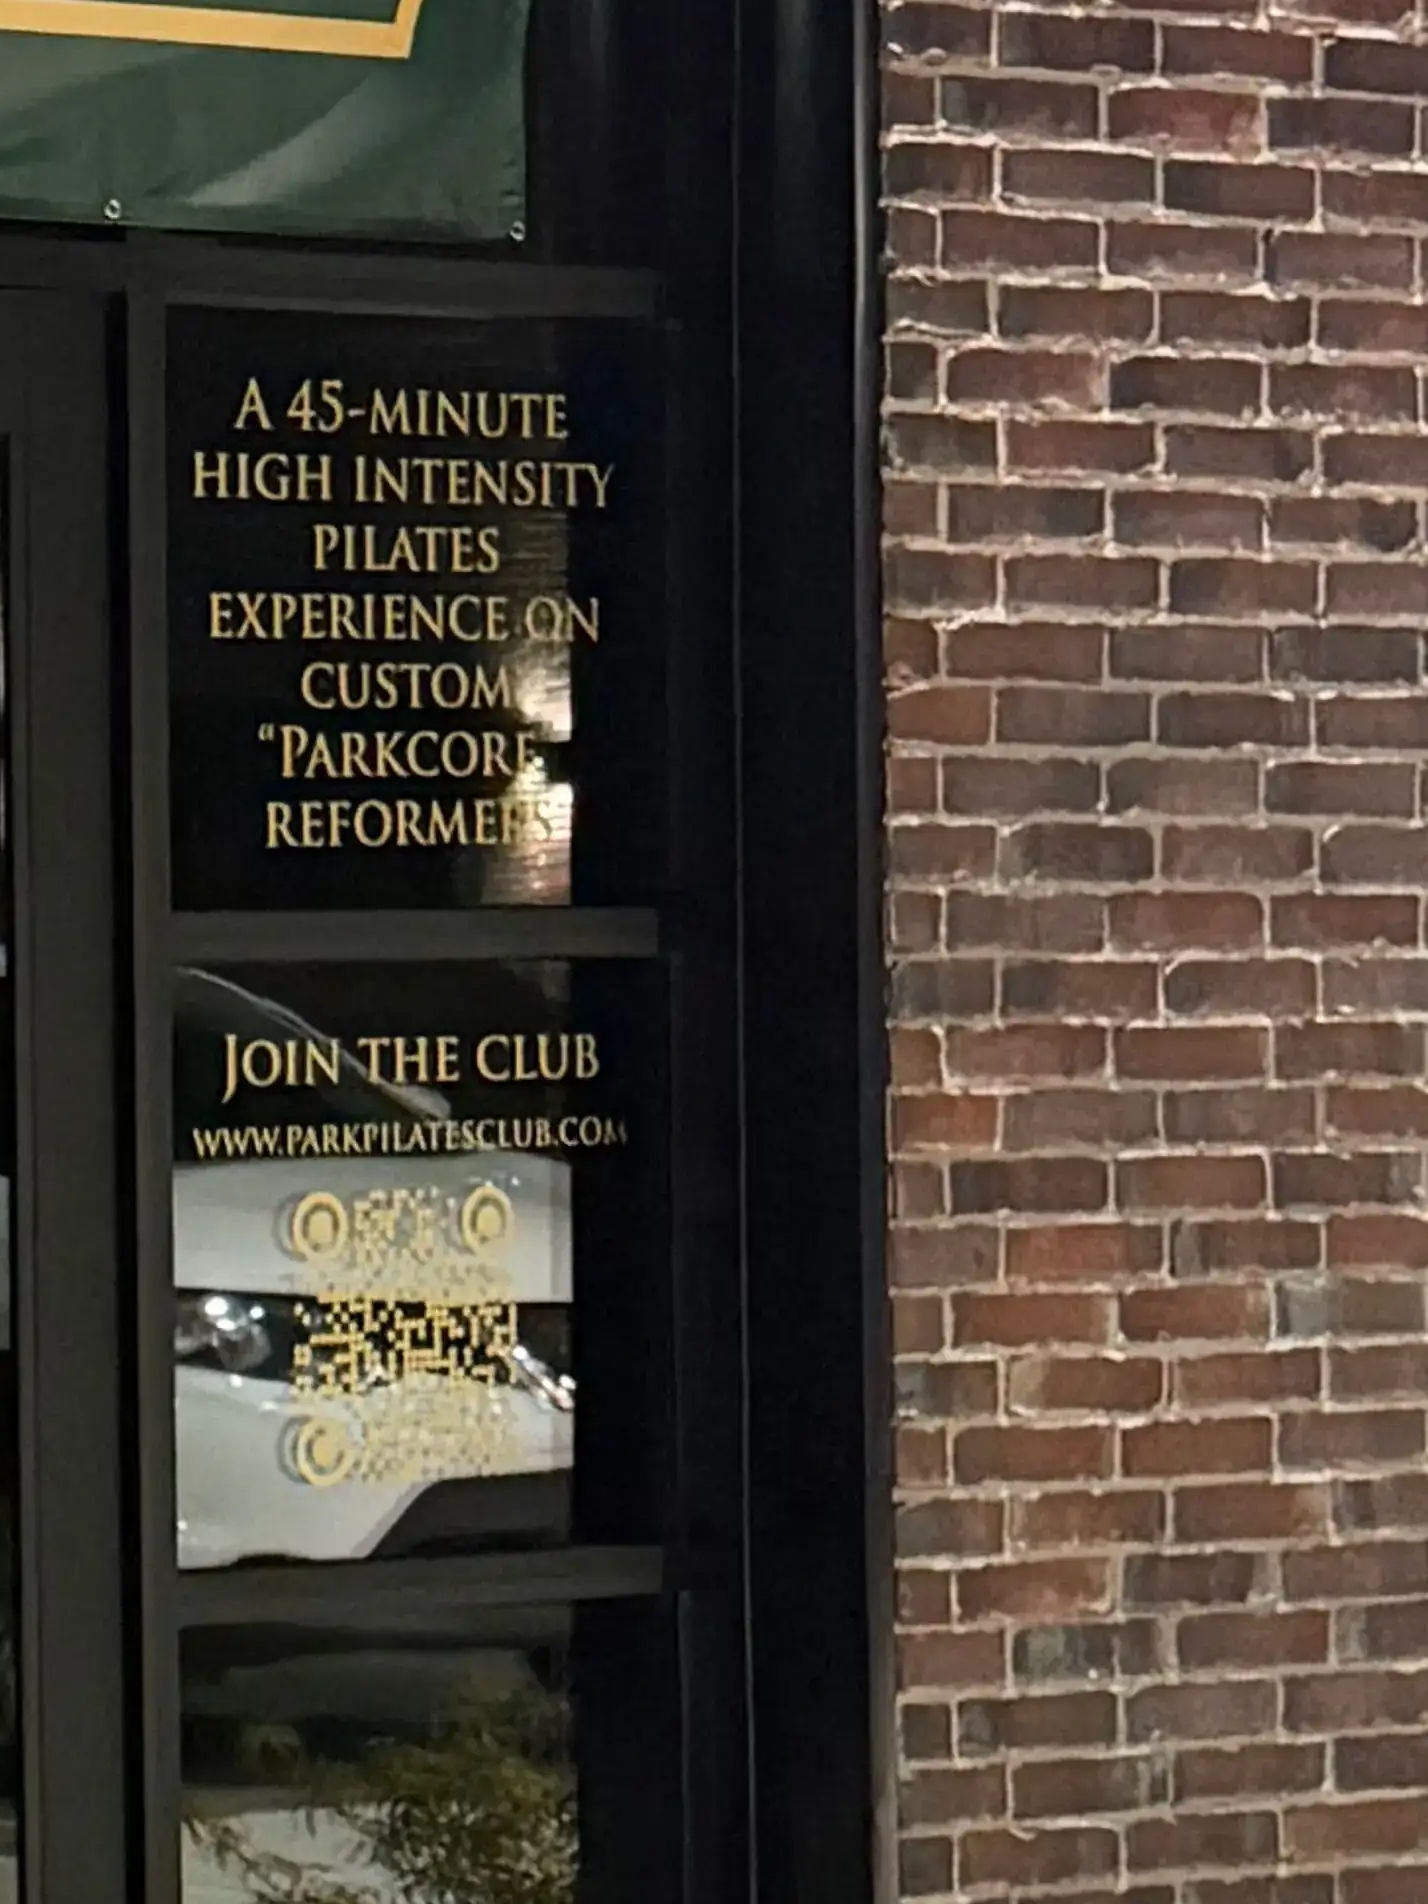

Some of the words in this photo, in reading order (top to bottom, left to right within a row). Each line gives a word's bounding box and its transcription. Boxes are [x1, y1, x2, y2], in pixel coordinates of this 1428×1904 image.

[234, 377, 274, 430] A
[287, 379, 569, 441] 45-MINUTE
[193, 451, 331, 501] HIGH
[354, 456, 615, 508] INTENSITY
[313, 525, 500, 573] PILATES
[209, 591, 508, 641] EXPERIENCE
[525, 597, 600, 642] ON
[301, 662, 512, 710] CUSTOM
[221, 1033, 341, 1103] JOIN
[358, 1036, 460, 1083] THE
[476, 1033, 599, 1082] CLUB
[193, 1114, 627, 1159] WWW.PARKPILATESCLUB.COM
